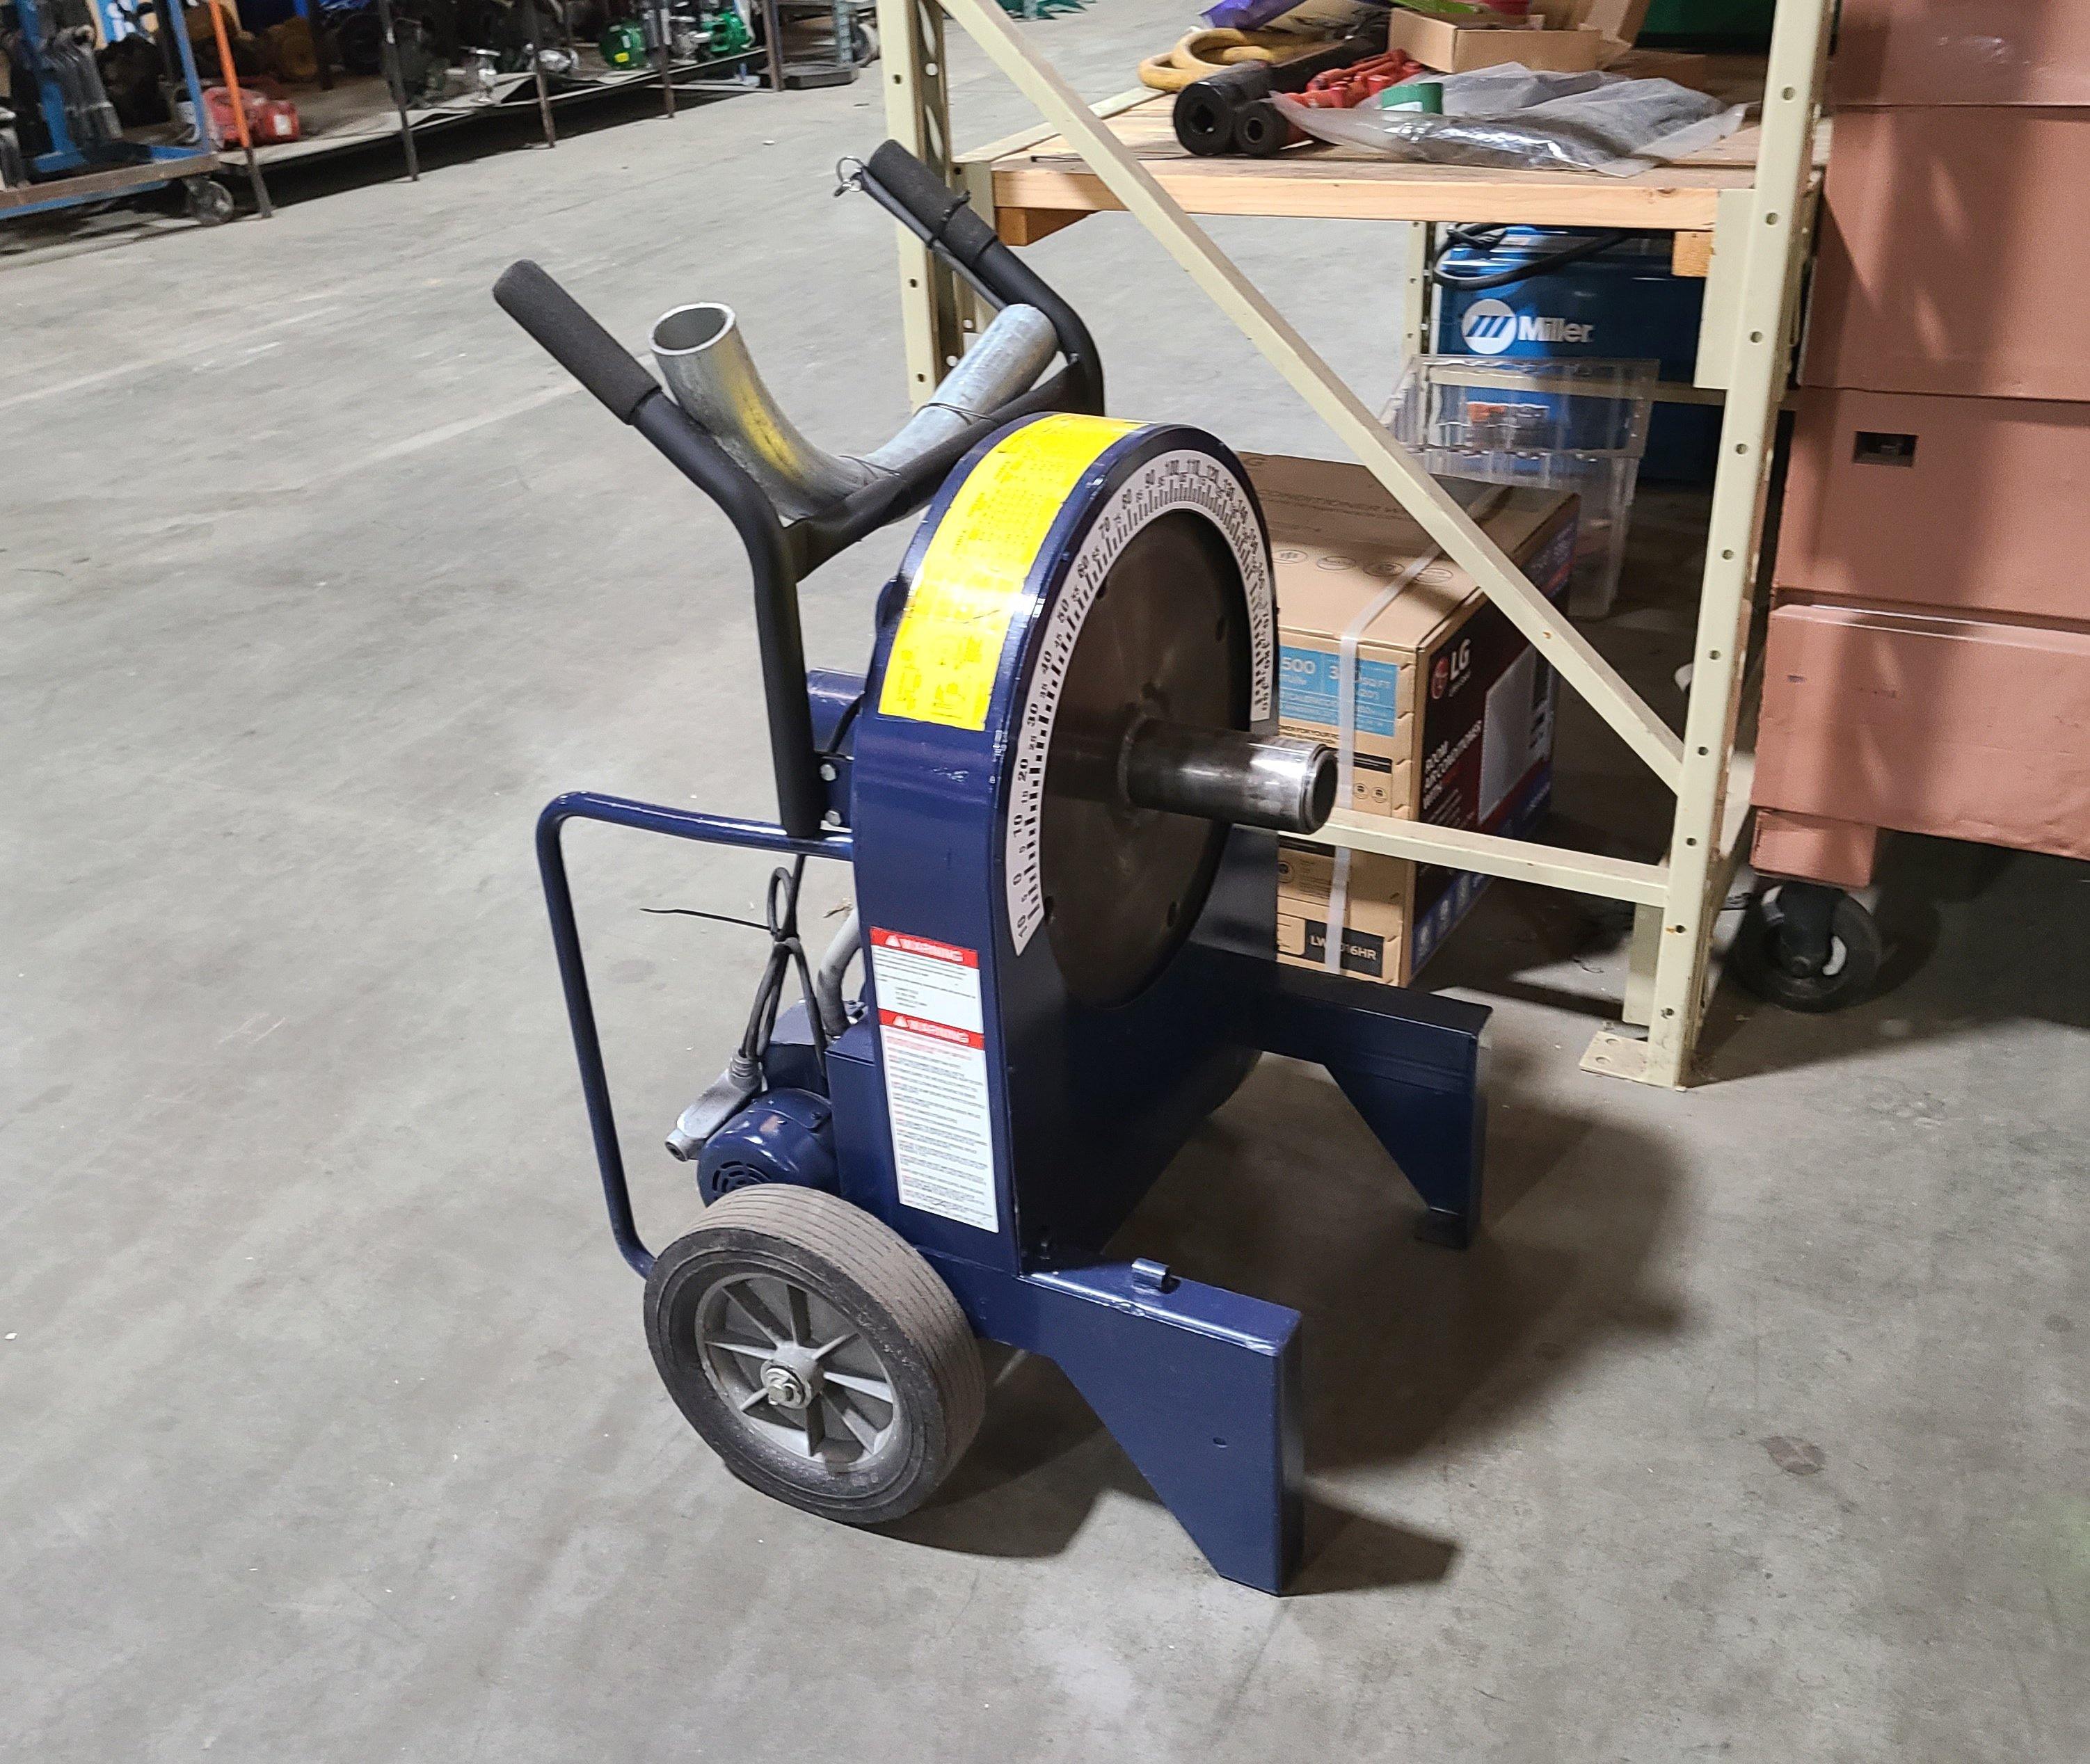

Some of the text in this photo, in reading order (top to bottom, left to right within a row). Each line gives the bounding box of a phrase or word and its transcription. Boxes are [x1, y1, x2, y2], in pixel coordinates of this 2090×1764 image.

[1518, 316, 1593, 342] Miller
[1145, 469, 1155, 488] 90
[1122, 488, 1131, 510] 80
[1098, 516, 1110, 539] 70
[1078, 555, 1090, 579] 60
[1058, 599, 1069, 623] 50
[1042, 650, 1052, 674] 40
[1450, 638, 1471, 680] LG
[1027, 703, 1038, 727] 30
[1018, 758, 1028, 782] 20
[1013, 815, 1023, 837] 10
[1013, 872, 1022, 885] 0
[1017, 915, 1028, 938] 10
[899, 938, 964, 962] WARNING
[906, 1019, 969, 1043] WARNING
